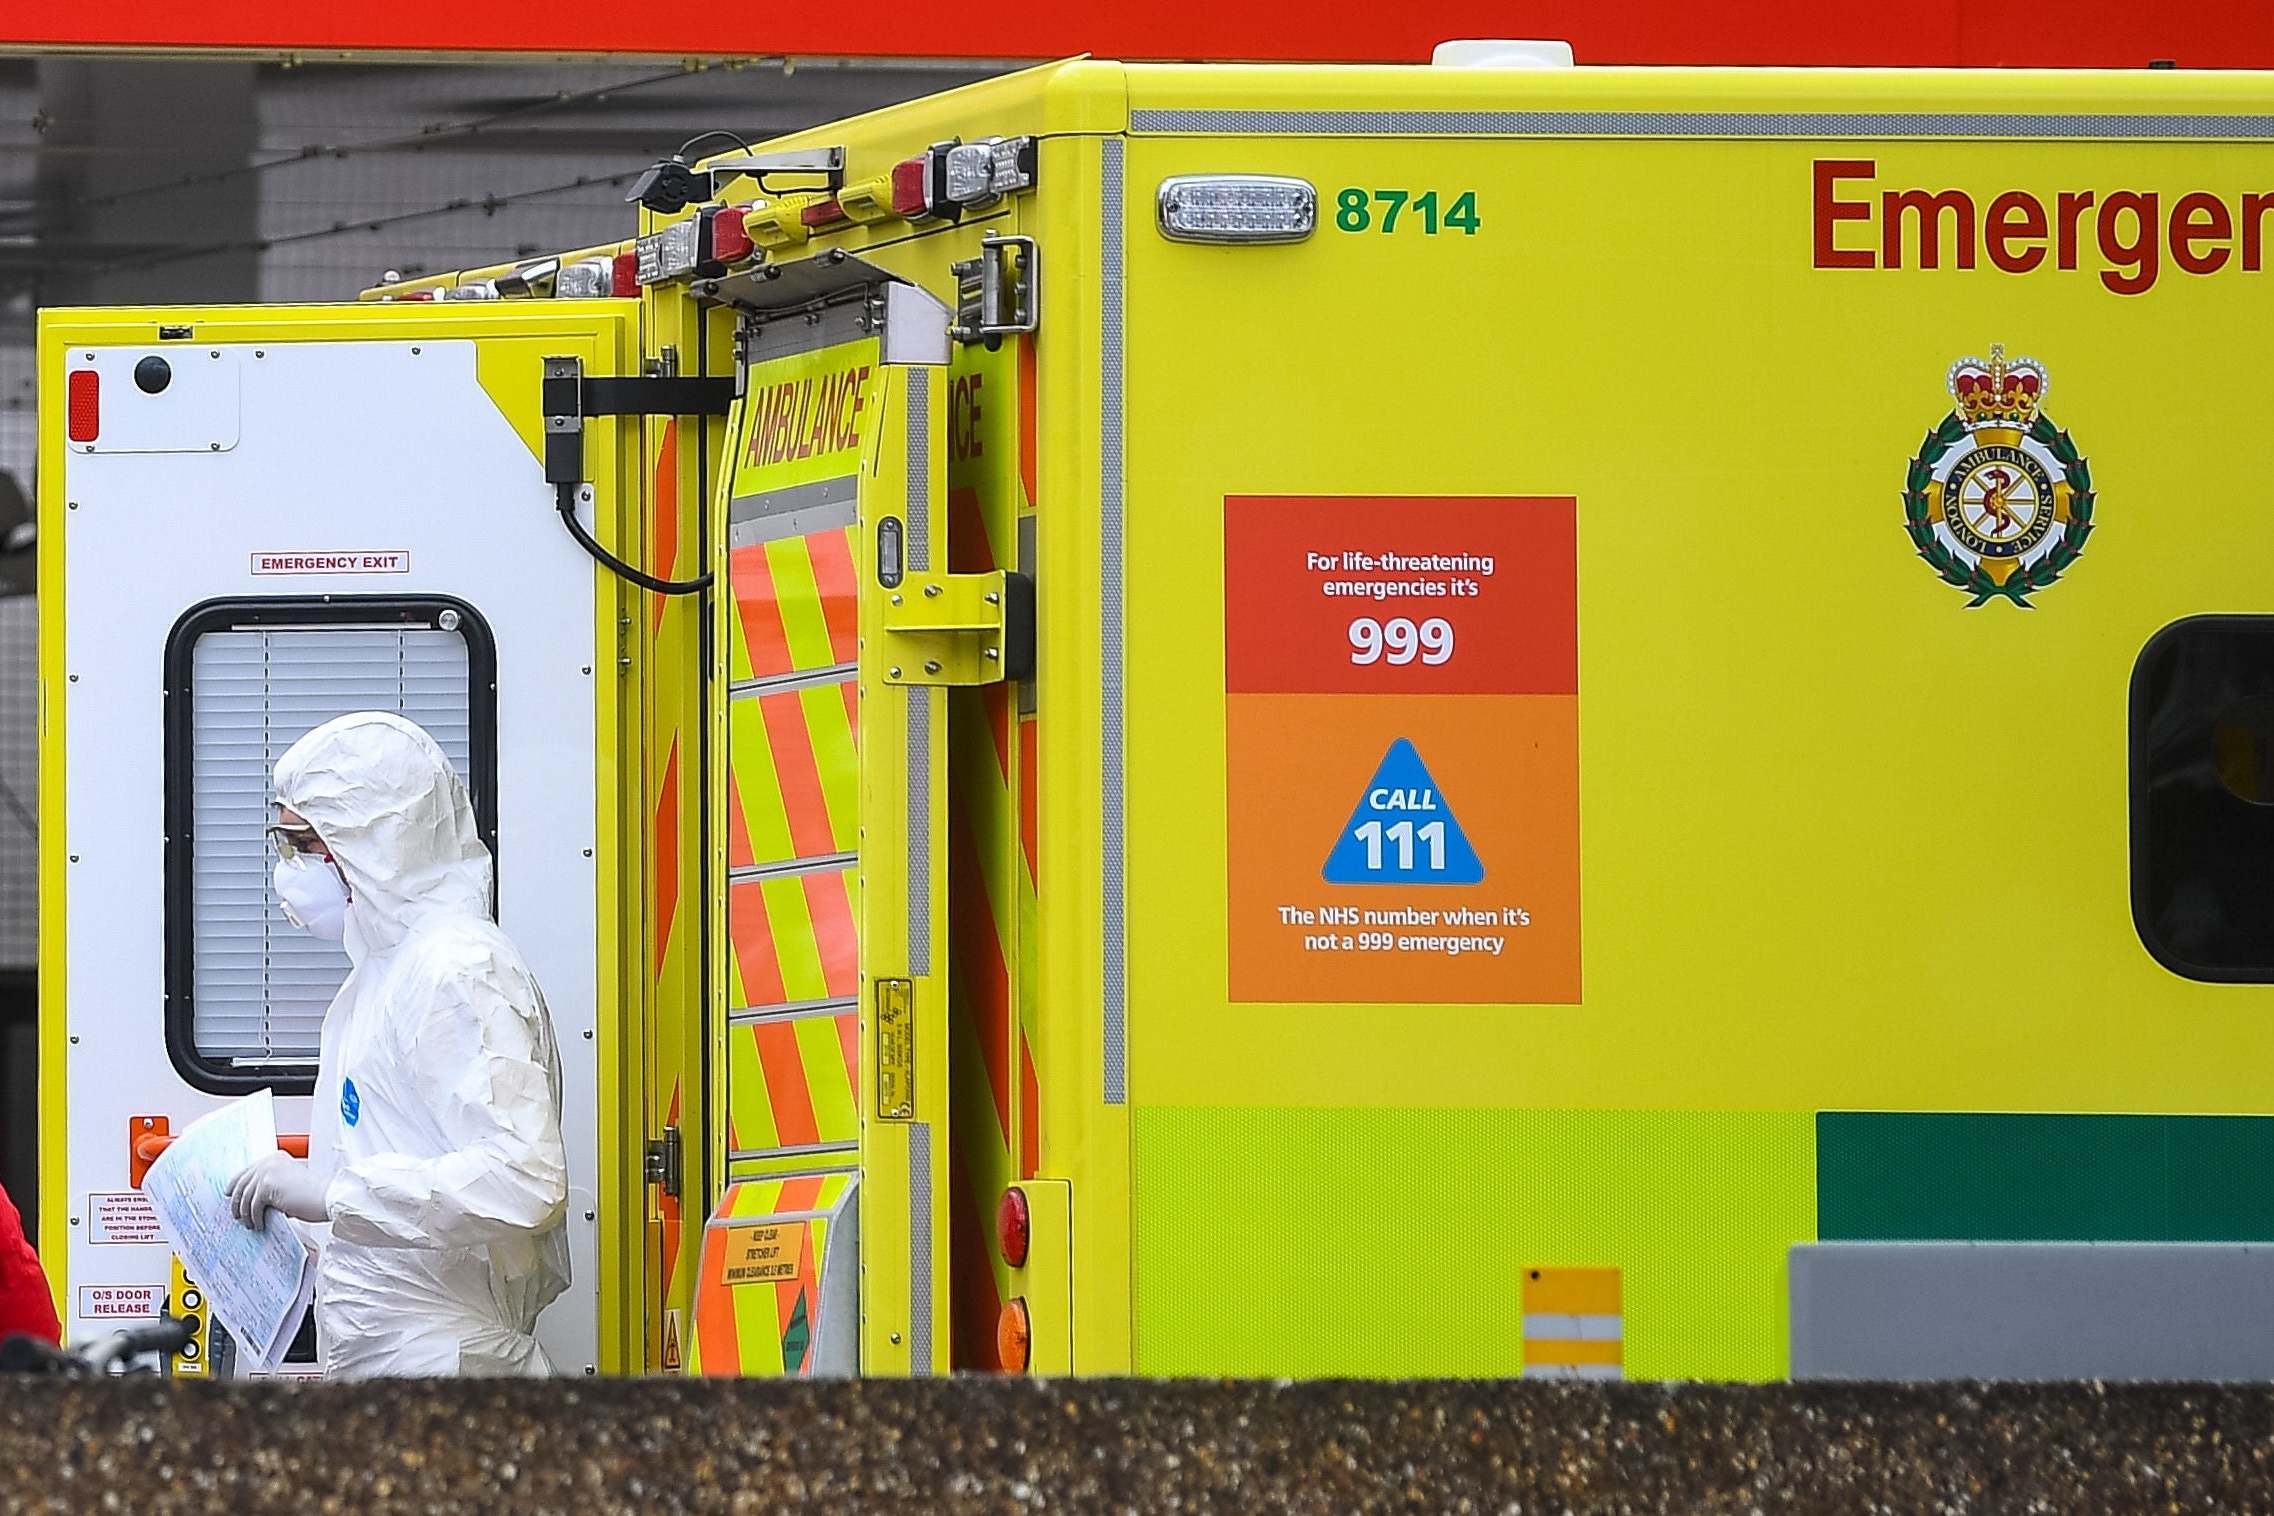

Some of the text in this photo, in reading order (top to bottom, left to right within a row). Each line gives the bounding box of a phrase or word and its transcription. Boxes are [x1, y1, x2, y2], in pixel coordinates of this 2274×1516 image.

[1336, 188, 1481, 235] 8714
[744, 366, 870, 469] AMBULANCE
[1945, 448, 2053, 553] LONDON AMBULANCE SERVICE
[261, 556, 398, 569] EMERGENCY EXIT
[1306, 552, 1495, 576] For life-threatening
[1322, 577, 1479, 600] emergencies it's
[1348, 617, 1455, 665] 999
[1369, 788, 1437, 810] CALL
[1354, 821, 1446, 870] 111
[1278, 907, 1531, 926] The NHS number when it's
[1304, 932, 1505, 956] not a 999 emergency
[92, 1290, 151, 1300] O/S DOOR
[94, 1303, 150, 1313] RELEASE
